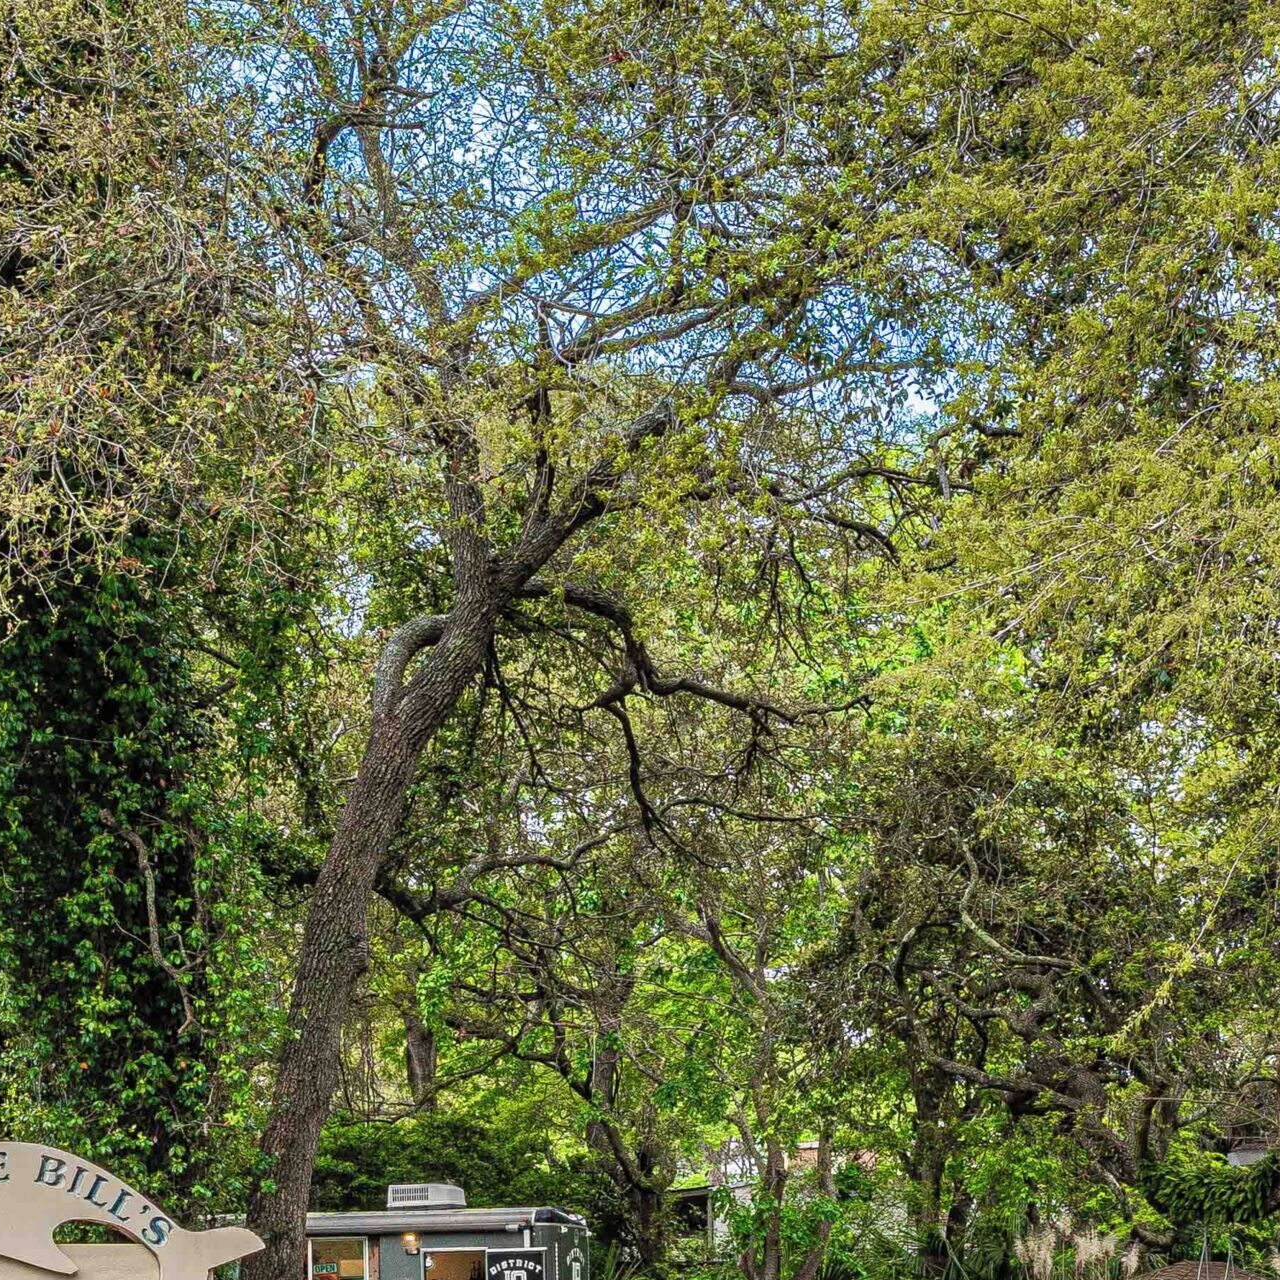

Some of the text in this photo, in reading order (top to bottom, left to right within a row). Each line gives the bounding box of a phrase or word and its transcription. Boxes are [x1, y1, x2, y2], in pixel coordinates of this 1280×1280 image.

[34, 1154, 176, 1249] BILL'S
[314, 1264, 335, 1273] OPEN
[489, 1259, 542, 1275] DISTRICT
